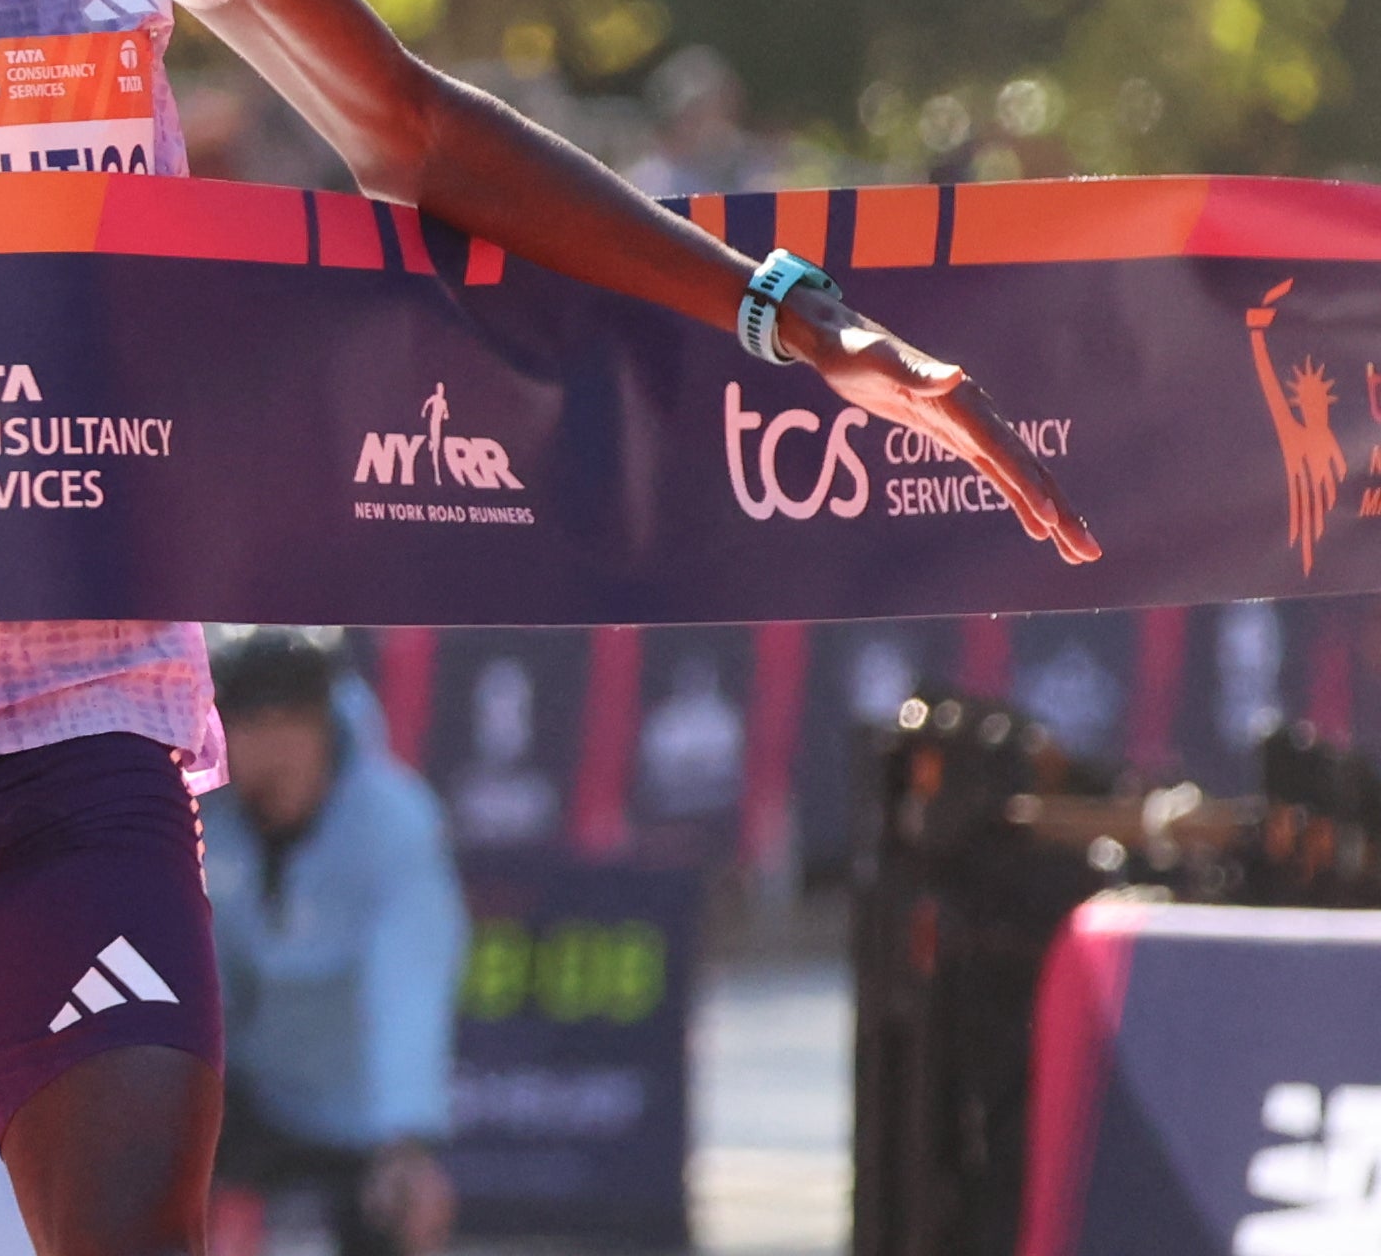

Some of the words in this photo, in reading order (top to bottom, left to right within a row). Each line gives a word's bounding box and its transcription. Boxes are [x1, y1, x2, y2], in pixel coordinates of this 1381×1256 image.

[4, 49, 45, 64] TATA
[6, 63, 97, 82] CONSULTANCY
[8, 82, 66, 100] SERVICES
[118, 75, 143, 93] TATA
[724, 381, 869, 520] tcs
[354, 502, 385, 520] NEW
[388, 504, 426, 521] YORK
[428, 505, 467, 522] ROAD
[469, 506, 535, 525] RUNNERS
